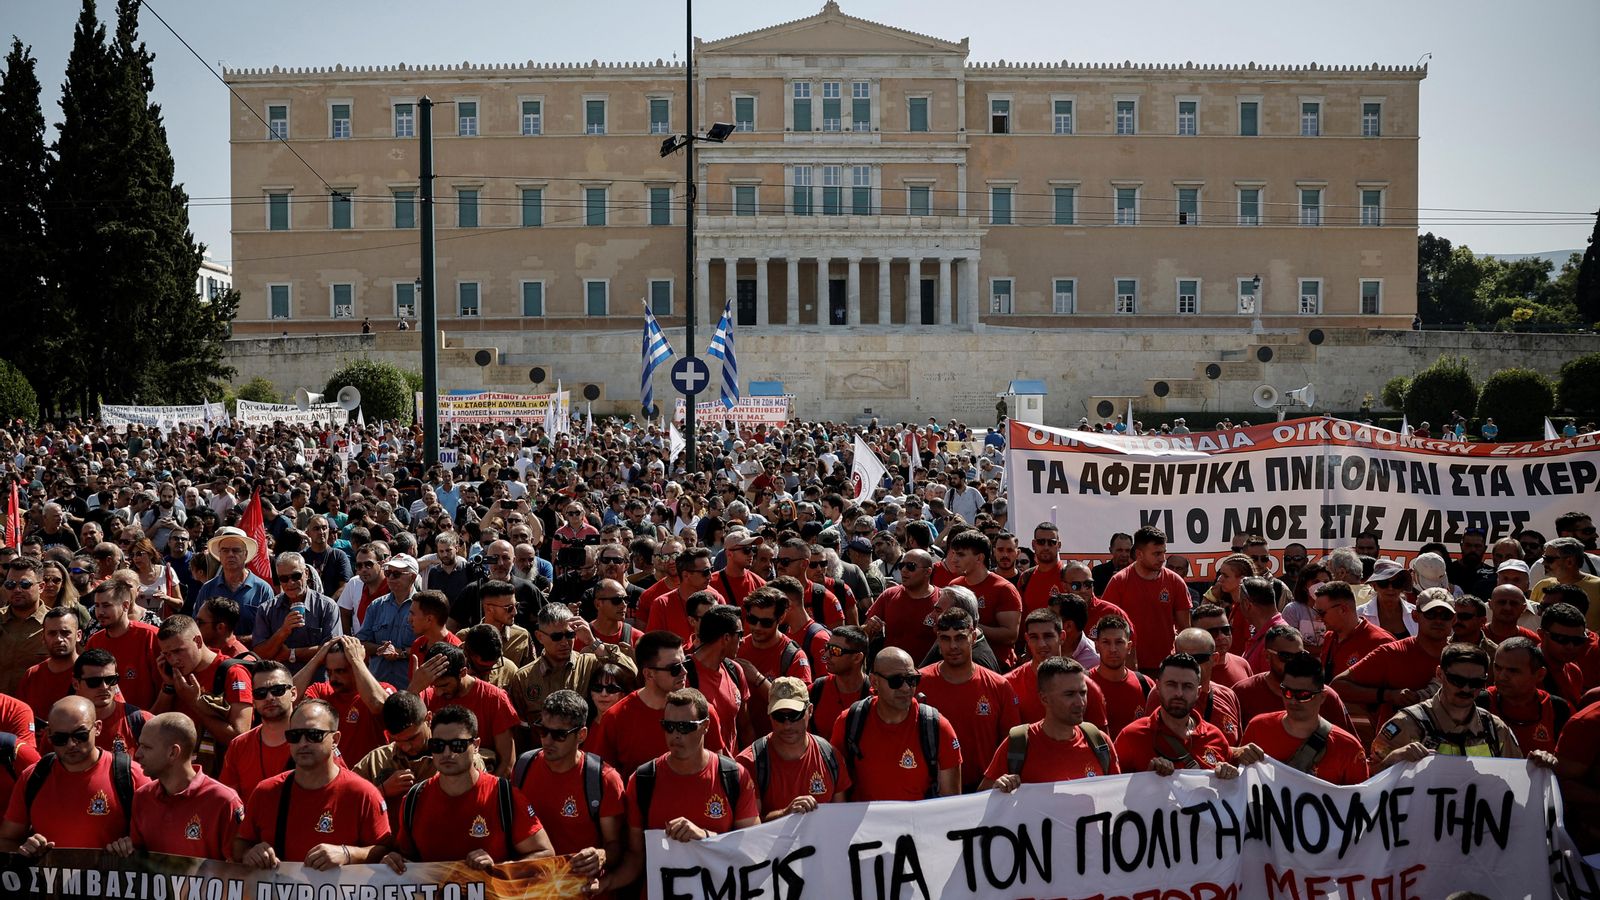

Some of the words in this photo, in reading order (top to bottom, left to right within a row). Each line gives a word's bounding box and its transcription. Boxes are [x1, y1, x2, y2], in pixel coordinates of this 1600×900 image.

[464, 401, 497, 409] ΣΤΑΘΕΡΗ
[1272, 419, 1476, 454] ΟΙΚΟΔΟΜΩΝ
[440, 452, 456, 463] ΟΧΙ
[1027, 459, 1069, 495] ΤΑ
[1079, 459, 1255, 496] ΑΦΕΝΤΙΚΑ
[1265, 455, 1441, 496] ΠΝΙΓΟΝΤΑΙ
[1449, 463, 1514, 497] ΣΤΑ
[1139, 509, 1174, 544] ΚΙ
[1186, 507, 1209, 544] Ο
[1221, 505, 1308, 543] ΛΑΟΣ
[1320, 504, 1386, 540] ΣΤΙΣ
[1394, 507, 1530, 544] ΛΑΣΠΕΣ
[848, 833, 930, 900] ΓΙΑ
[946, 817, 1052, 892] ΤΟΝ
[1075, 799, 1242, 877] ΠΟΛΙΤΗ
[1427, 784, 1514, 855] ΤΗΝ
[29, 867, 244, 900] ΣΥΜΒΑΣΙΟΥΧΩΝ
